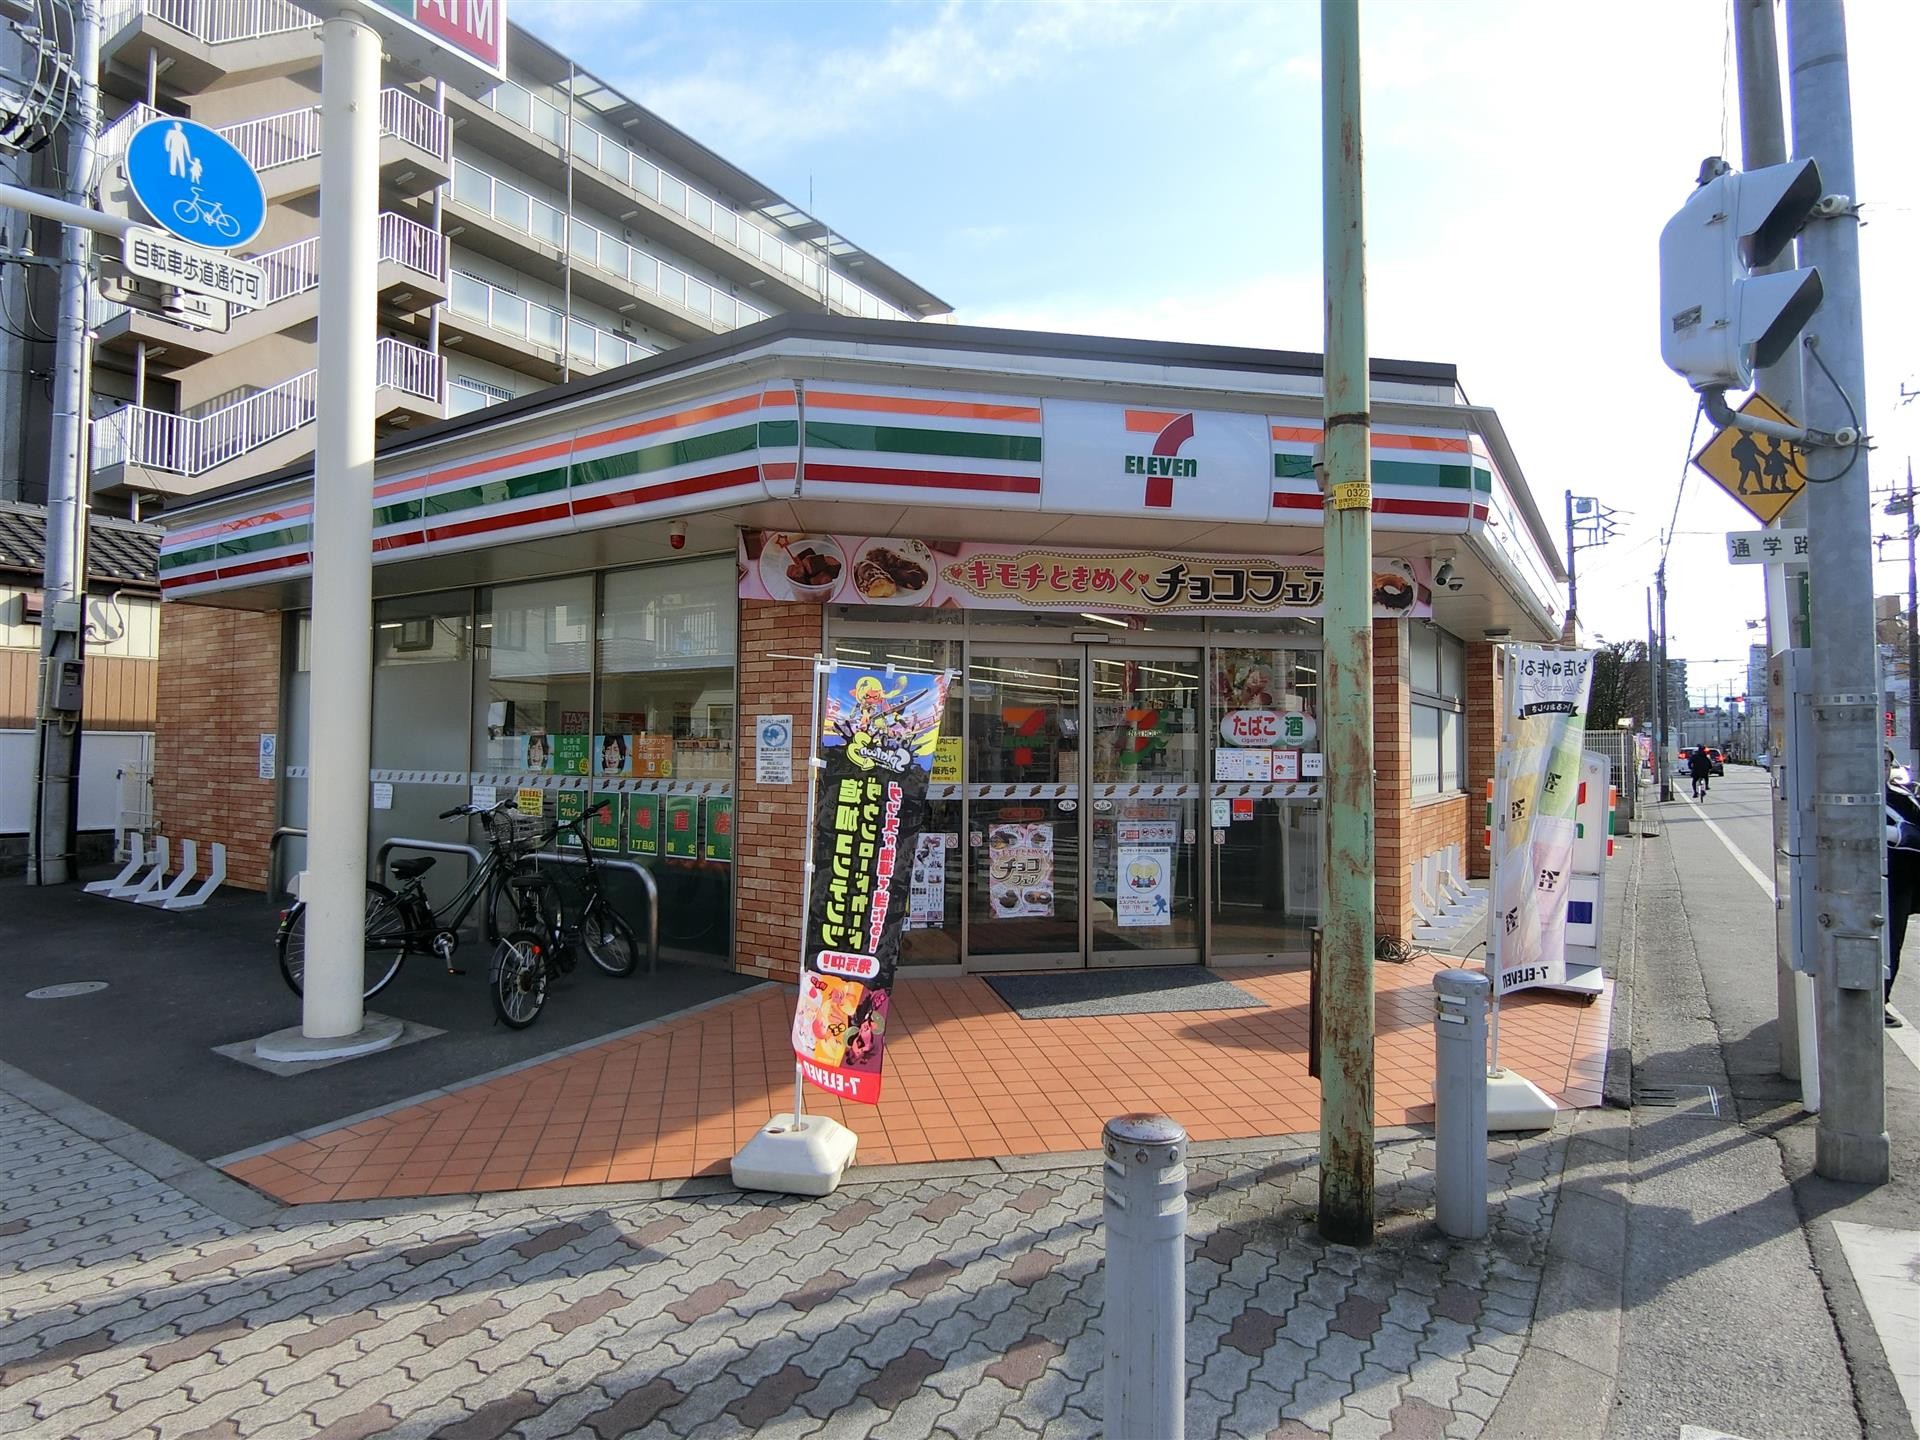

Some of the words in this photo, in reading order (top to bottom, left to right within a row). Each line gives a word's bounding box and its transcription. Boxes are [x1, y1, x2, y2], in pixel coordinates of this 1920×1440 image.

[421, 0, 494, 46] TM
[133, 238, 261, 301] 自転車歩道通行可
[1731, 535, 1809, 558] 通学路
[967, 559, 1137, 593] キモチときめく
[1232, 715, 1277, 736] たばこ
[1285, 716, 1304, 737] 酒
[674, 810, 689, 832] 直
[991, 857, 1042, 881] チョコ
